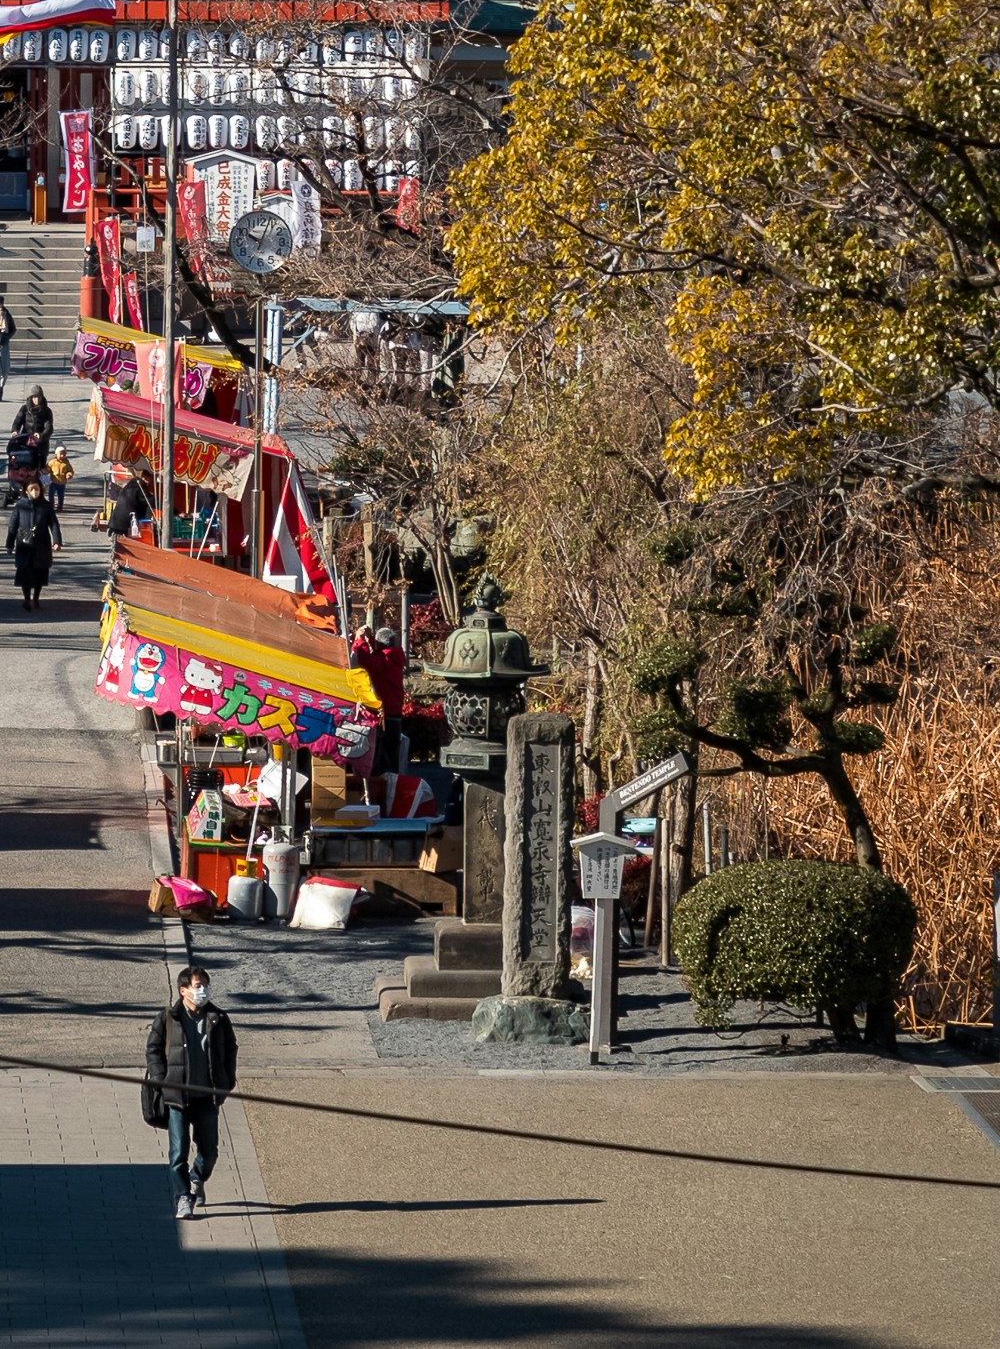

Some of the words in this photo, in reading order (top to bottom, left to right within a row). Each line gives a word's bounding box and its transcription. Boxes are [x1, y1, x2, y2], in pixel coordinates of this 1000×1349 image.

[71, 136, 86, 206] おみくじ
[216, 161, 232, 236] 巳成金大祭
[279, 238, 286, 247] 3
[239, 248, 247, 257] 8
[256, 258, 264, 267] 6
[267, 256, 275, 265] 5
[215, 683, 371, 759] カステラ
[651, 760, 676, 781] TEMPLE
